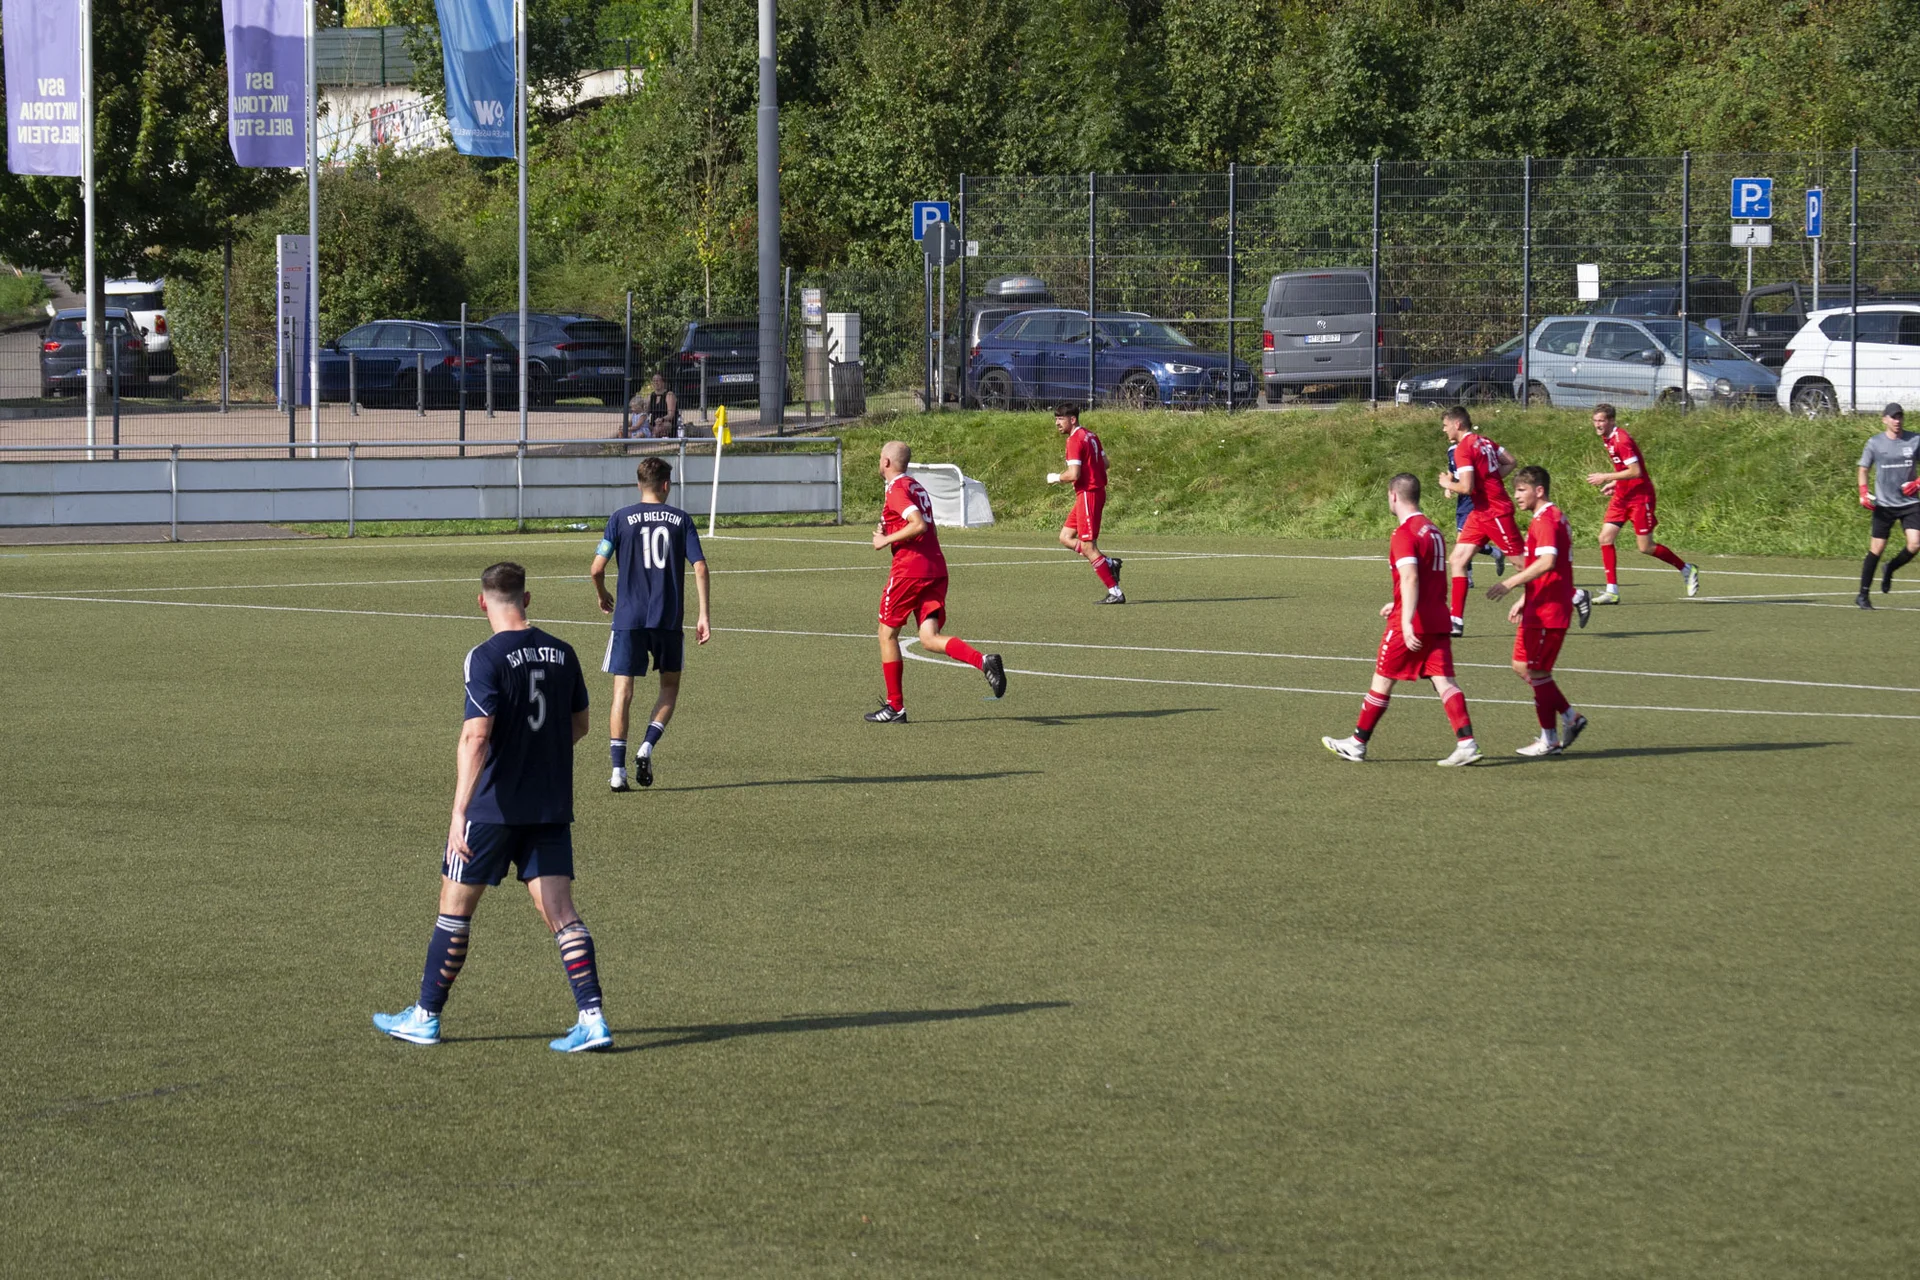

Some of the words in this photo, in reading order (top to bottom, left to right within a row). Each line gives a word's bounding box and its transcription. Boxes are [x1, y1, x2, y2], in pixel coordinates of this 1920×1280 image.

[1740, 183, 1763, 214] P
[1808, 195, 1819, 231] P
[922, 206, 942, 236] P
[626, 512, 642, 526] BSV
[643, 511, 682, 527] BIELSTEIN
[639, 525, 670, 570] 10
[506, 648, 524, 668] BSV
[527, 668, 547, 732] 5
